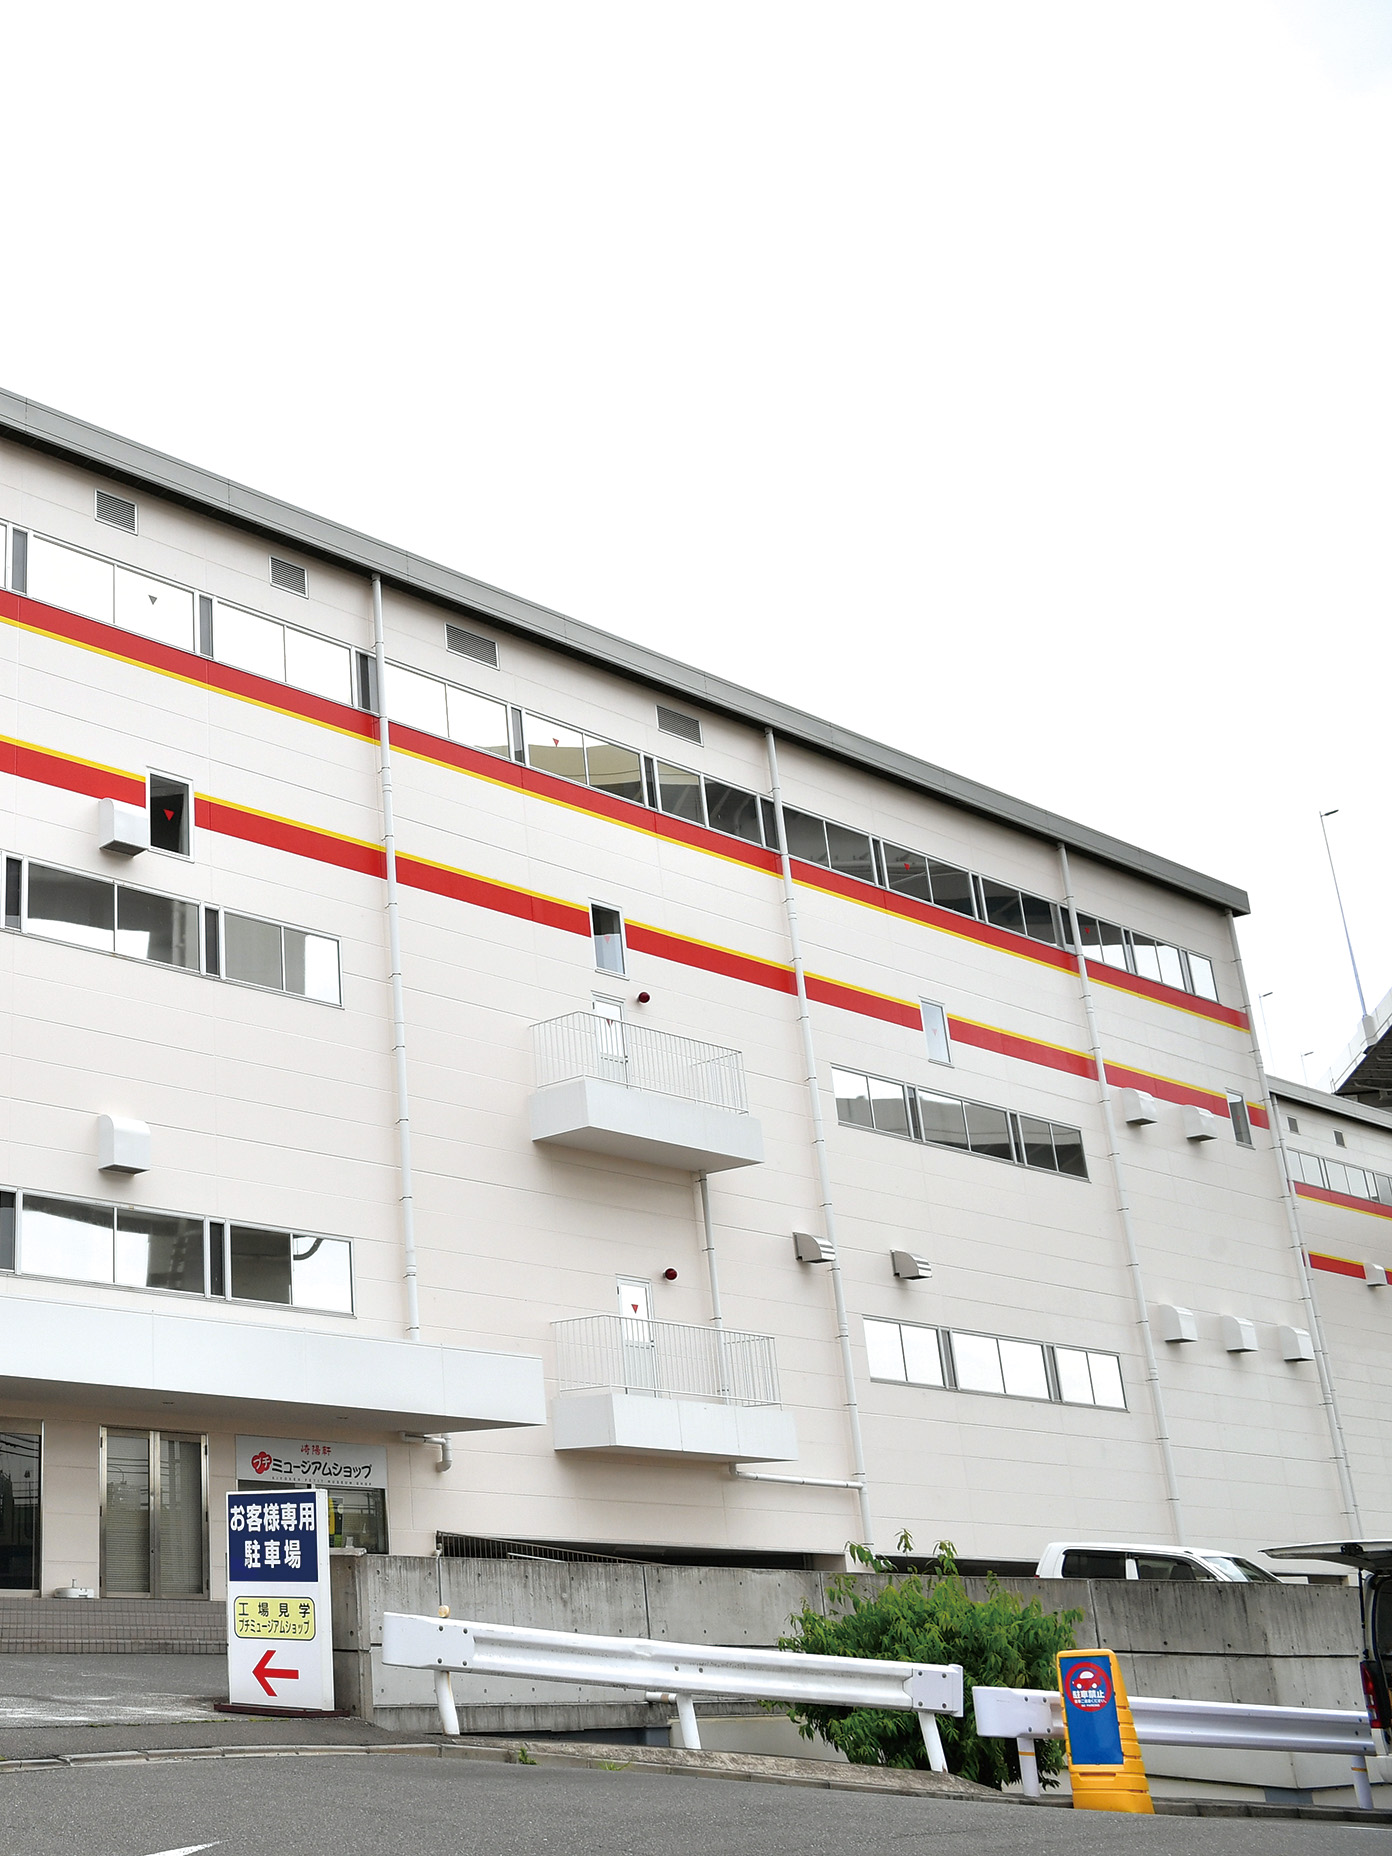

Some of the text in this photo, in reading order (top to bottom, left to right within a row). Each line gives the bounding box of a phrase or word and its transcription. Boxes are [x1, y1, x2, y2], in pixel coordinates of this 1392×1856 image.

[301, 1444, 332, 1456] 崎陽軒
[230, 1502, 315, 1532] お客様専用
[244, 1539, 301, 1569] 駐車場
[238, 1602, 310, 1618] 工場見学
